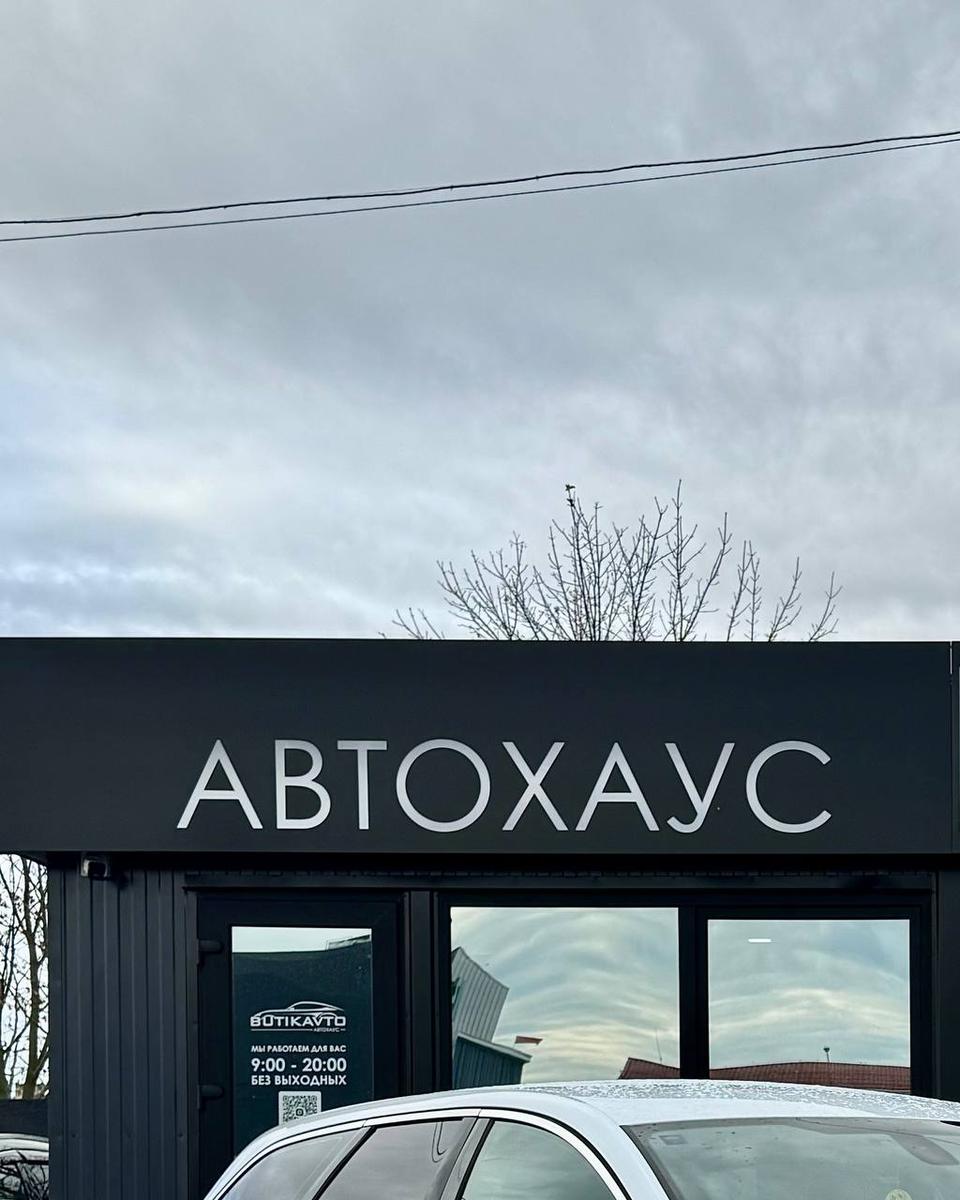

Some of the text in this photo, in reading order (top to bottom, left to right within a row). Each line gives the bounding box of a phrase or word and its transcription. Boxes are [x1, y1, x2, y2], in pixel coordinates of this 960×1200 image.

[176, 738, 833, 833] АВТОХАУС
[250, 1015, 346, 1027] BUTIKAVTO
[310, 1045, 328, 1053] ДЛЯ
[251, 1058, 286, 1072] 9:00
[302, 1058, 347, 1072] 20:00
[251, 1075, 347, 1086] БЕЗ ВЫХОДНЫХ
